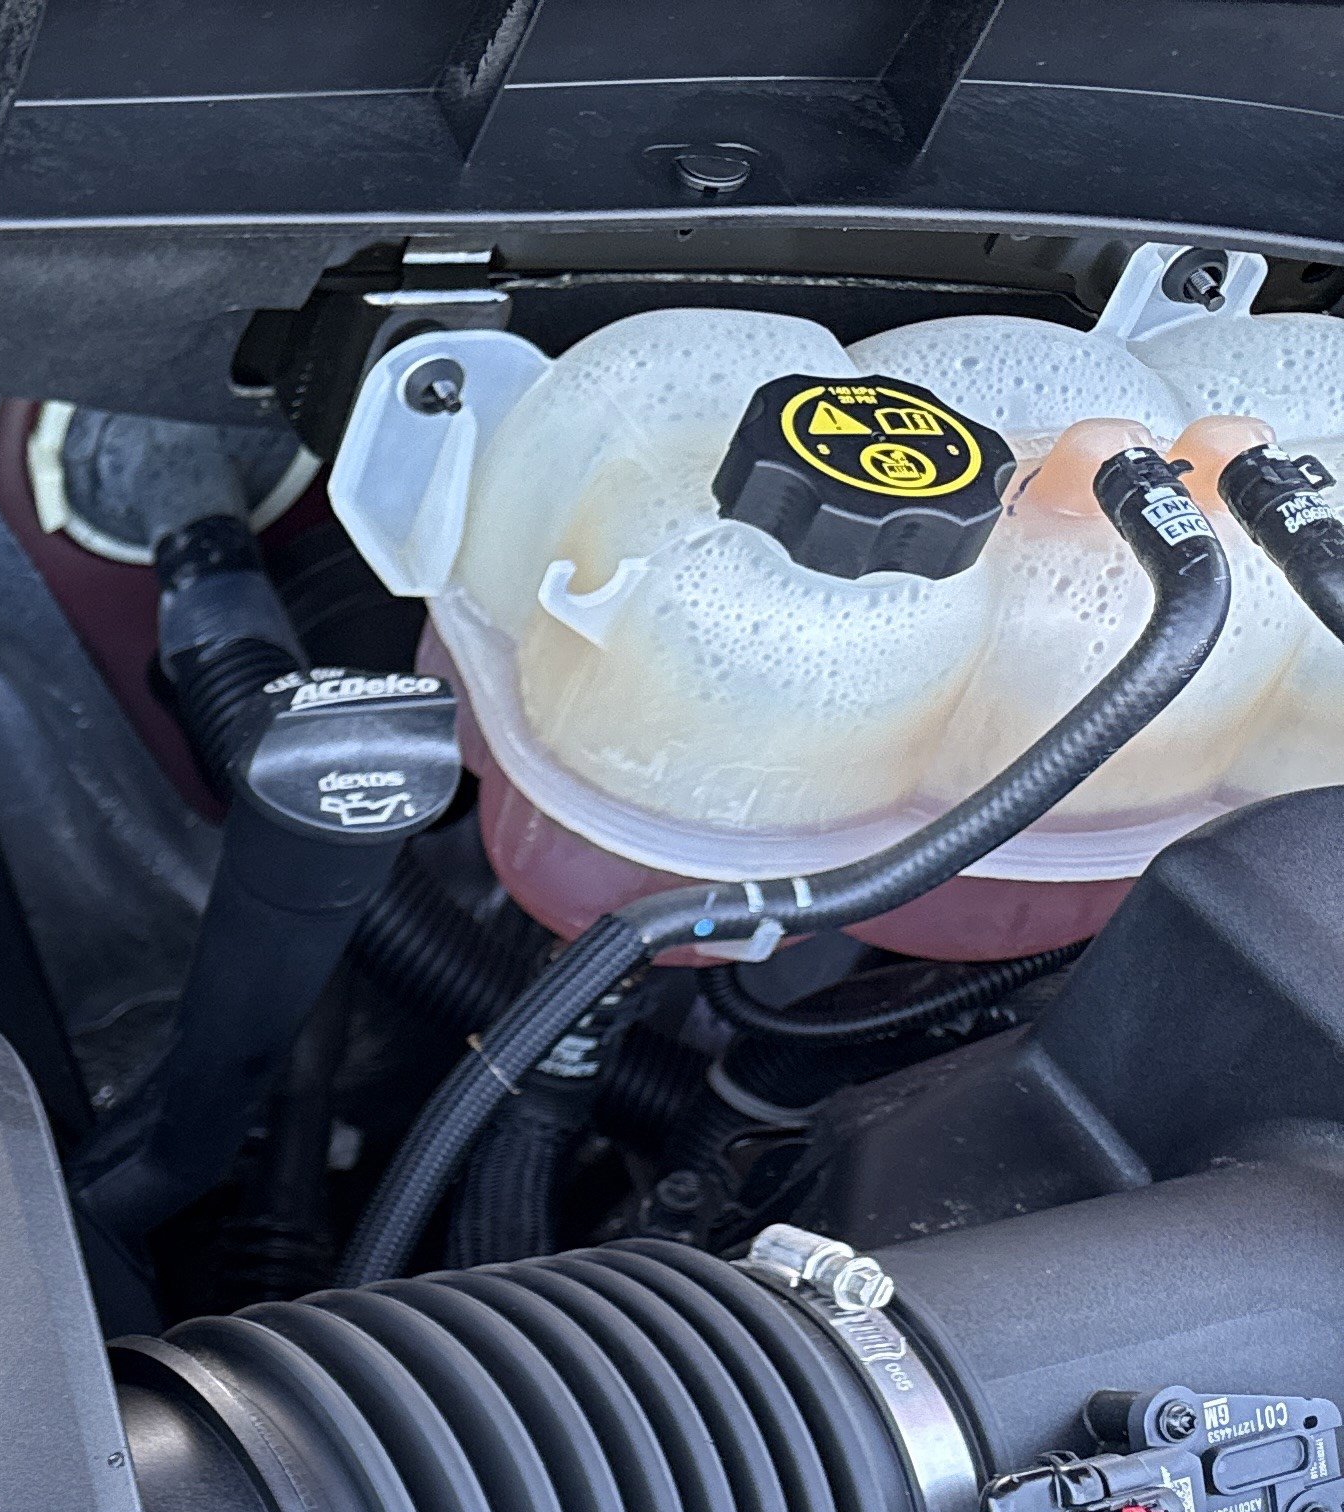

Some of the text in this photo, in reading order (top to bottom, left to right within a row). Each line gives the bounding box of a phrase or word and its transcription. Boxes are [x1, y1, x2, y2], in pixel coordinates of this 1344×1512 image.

[1148, 499, 1196, 520] TNK
[1276, 495, 1313, 517] TNK
[1164, 518, 1210, 540] ENG
[290, 673, 442, 706] ACDelco
[318, 770, 407, 792] dexos
[1203, 1404, 1230, 1431] GM
[1255, 1402, 1289, 1432] C01
